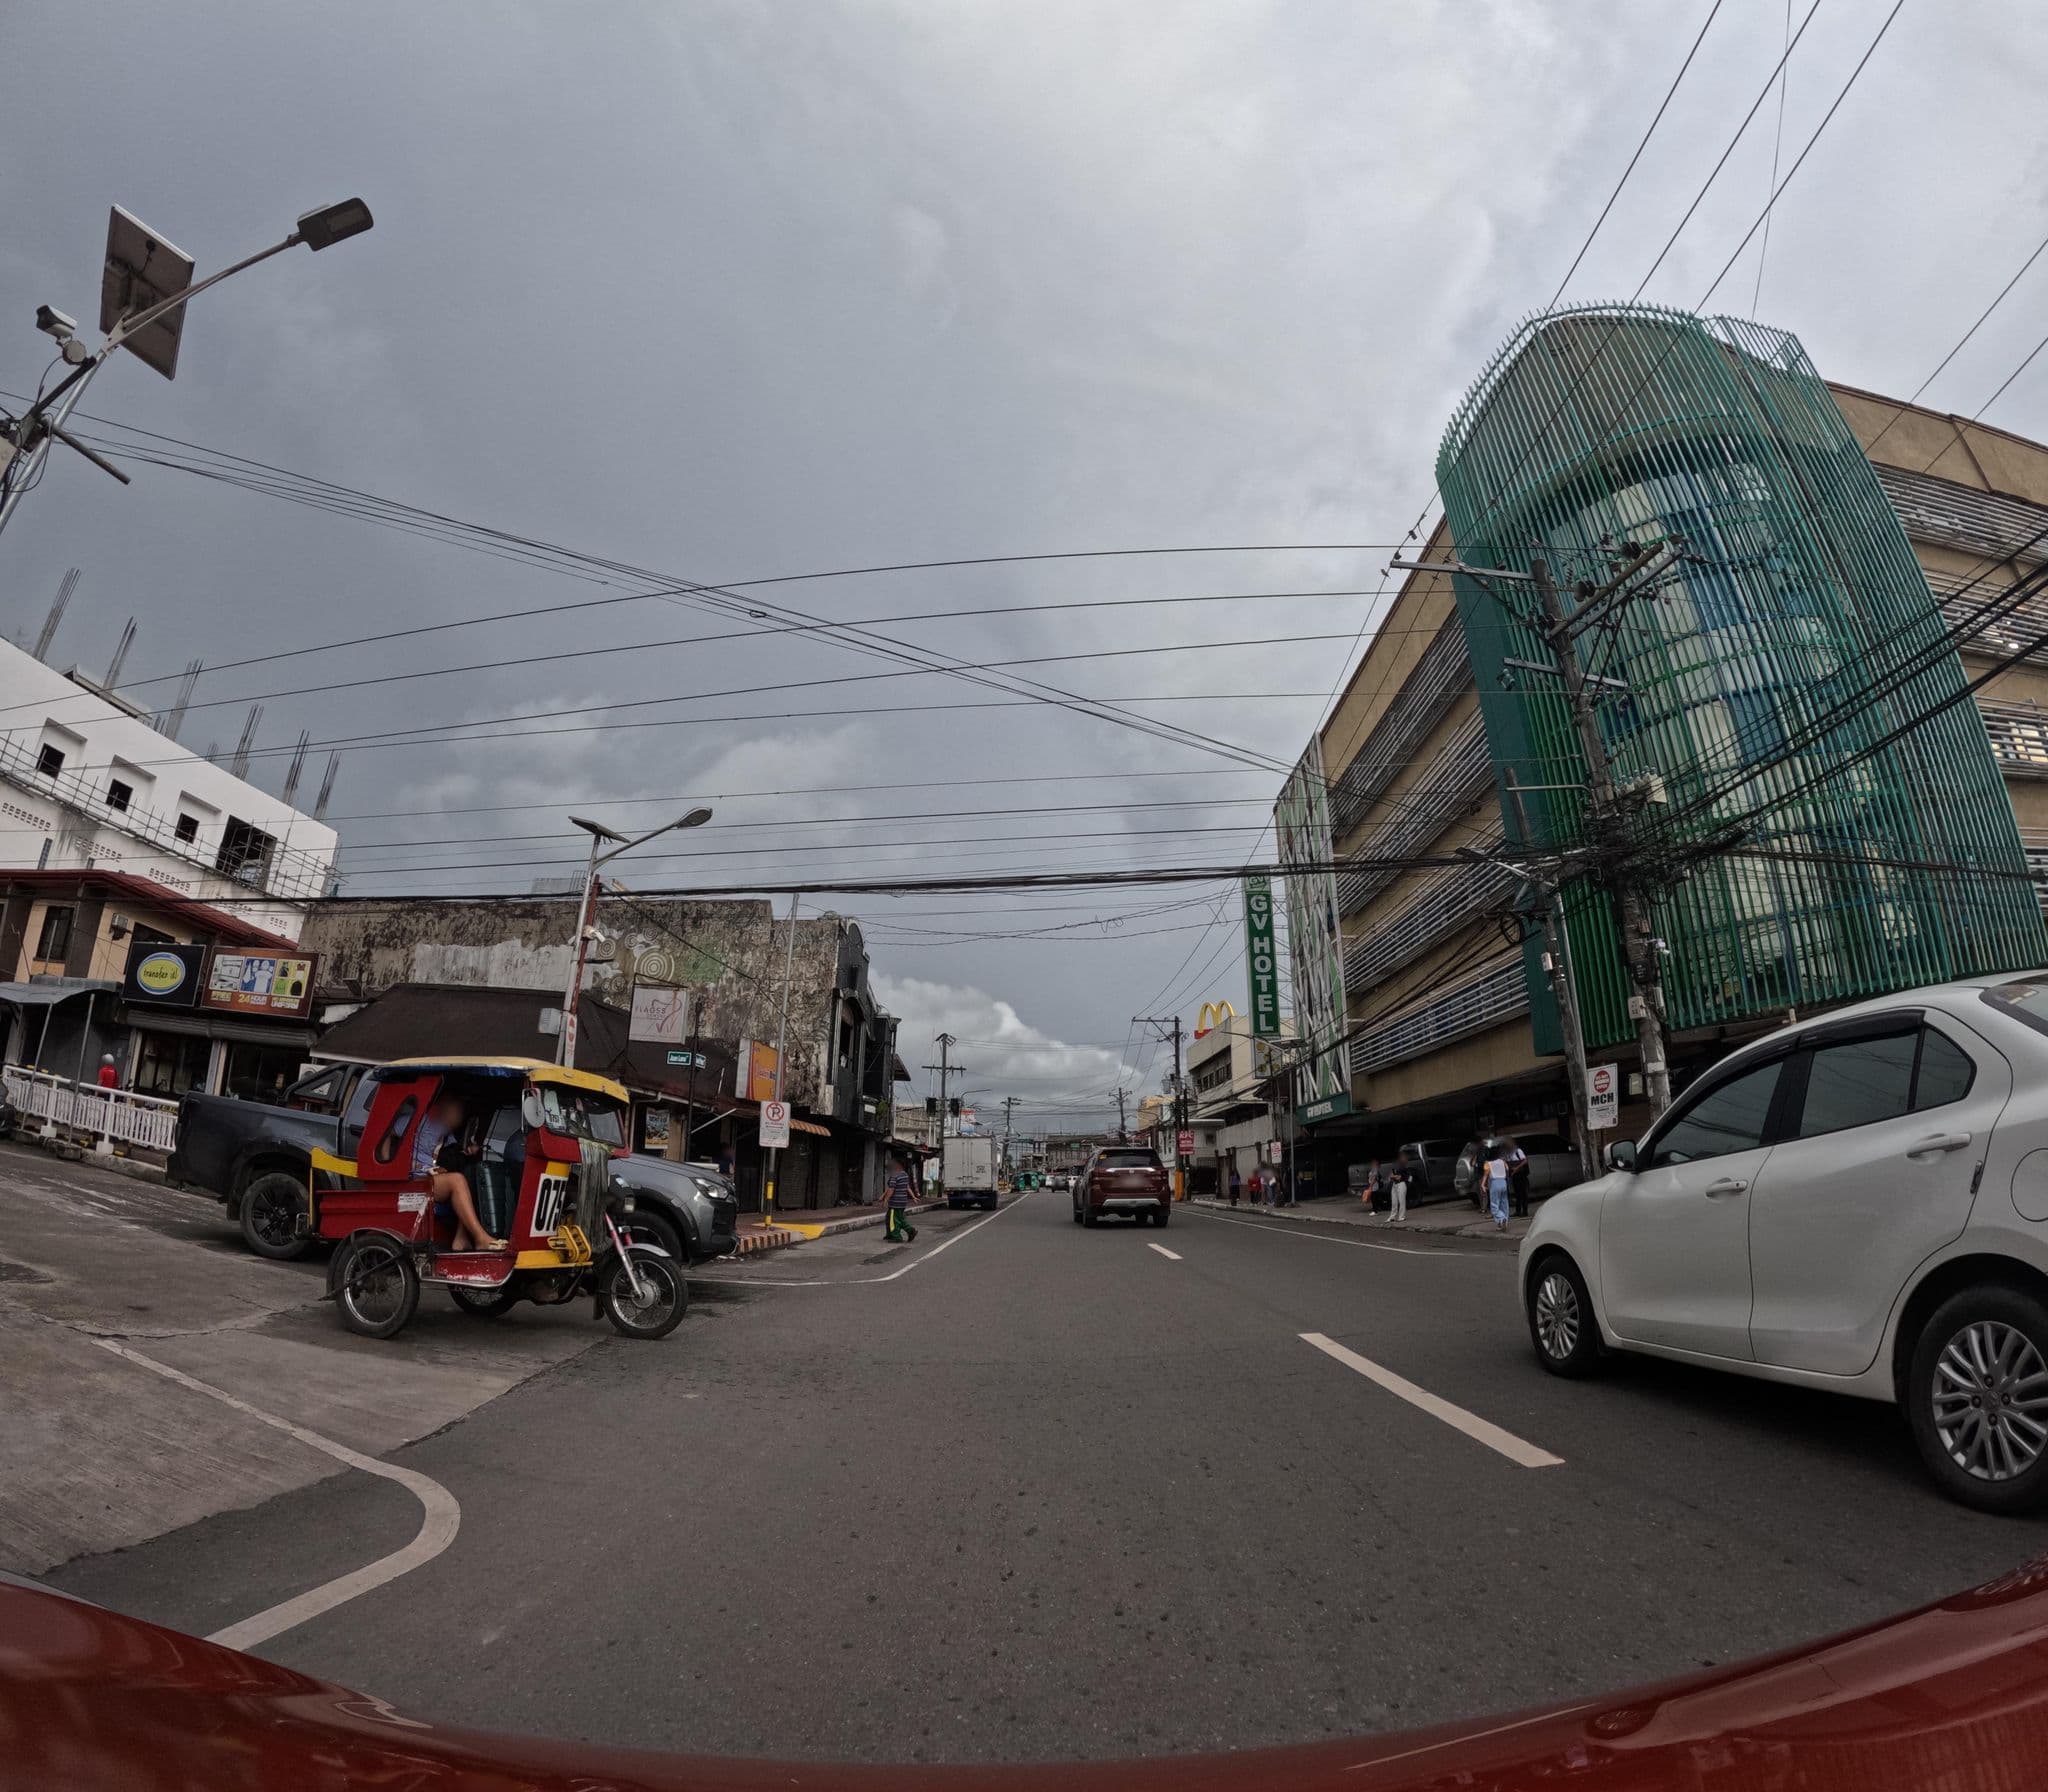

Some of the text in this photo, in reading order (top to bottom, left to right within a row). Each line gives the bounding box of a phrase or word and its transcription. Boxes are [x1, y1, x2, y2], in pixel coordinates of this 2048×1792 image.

[1250, 895, 1274, 1032] GV HOTEL
[238, 993, 251, 1004] 24
[1591, 1092, 1614, 1106] MCH
